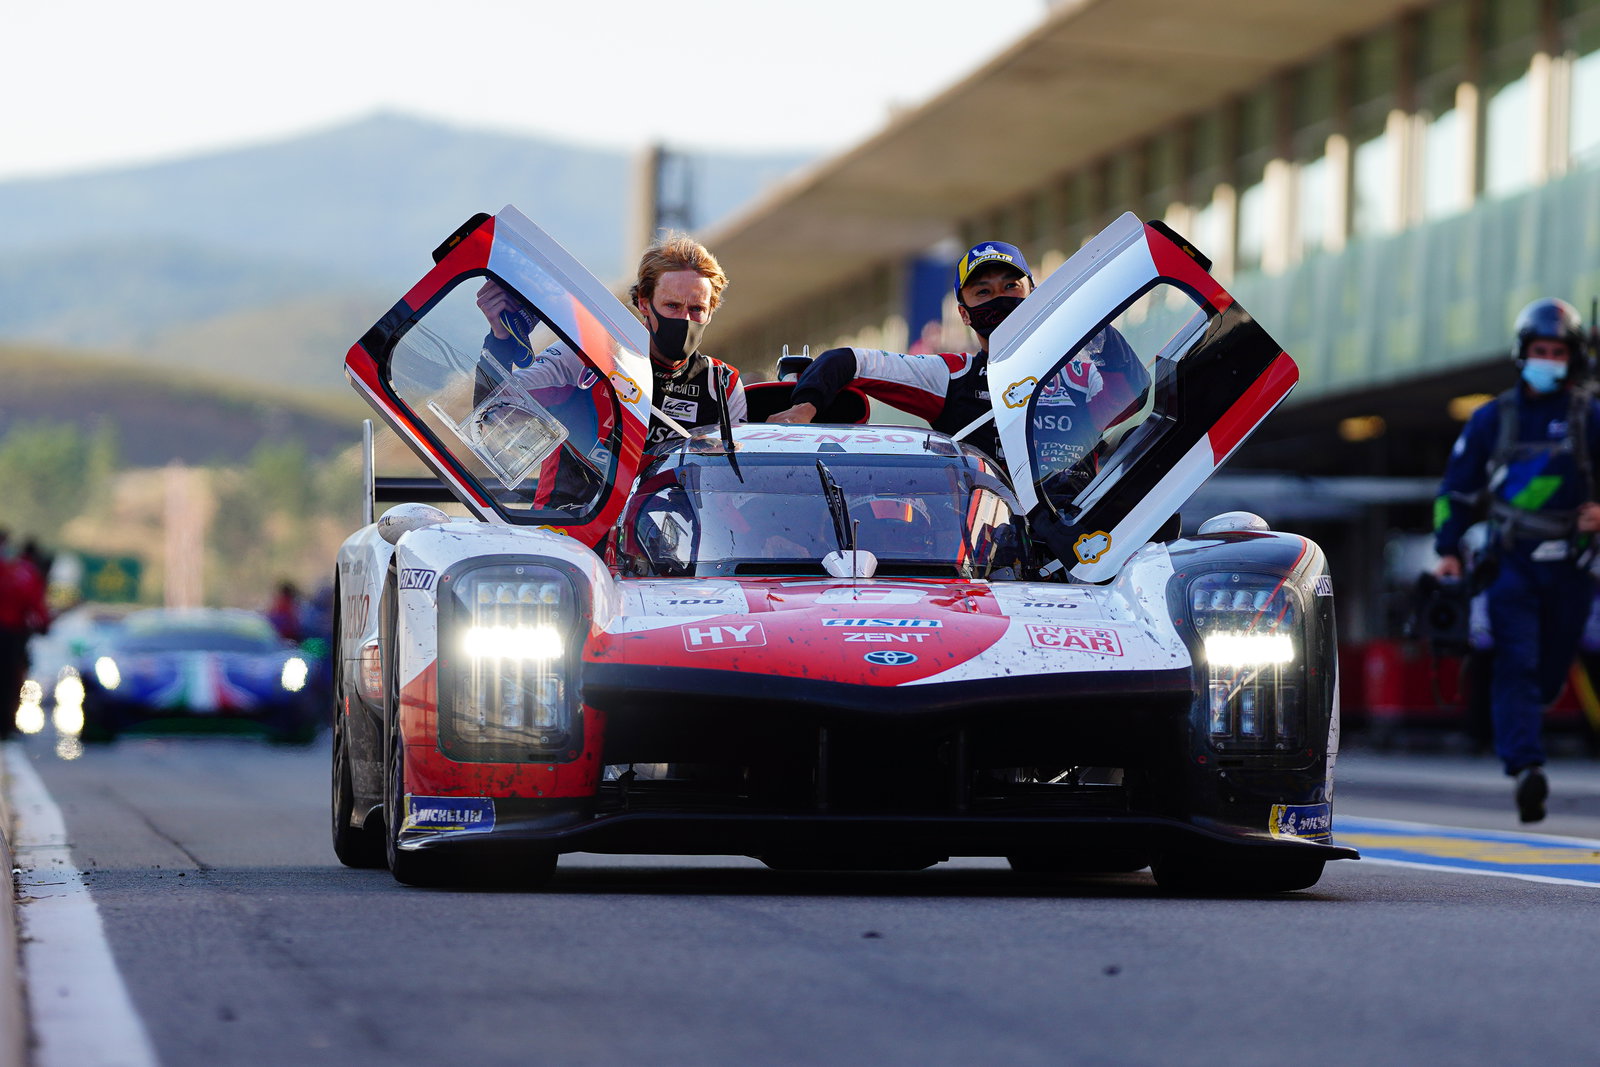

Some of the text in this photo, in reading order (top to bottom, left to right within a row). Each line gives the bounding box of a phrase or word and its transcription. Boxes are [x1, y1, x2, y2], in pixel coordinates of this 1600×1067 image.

[664, 400, 695, 413] WEC
[739, 432, 916, 444] DENSO
[401, 570, 435, 589] AISIN
[689, 624, 755, 645] HY
[842, 632, 930, 642] ZENT
[1032, 626, 1111, 638] HYPER
[1036, 633, 1116, 652] CAR
[418, 808, 483, 823] MICHELIN
